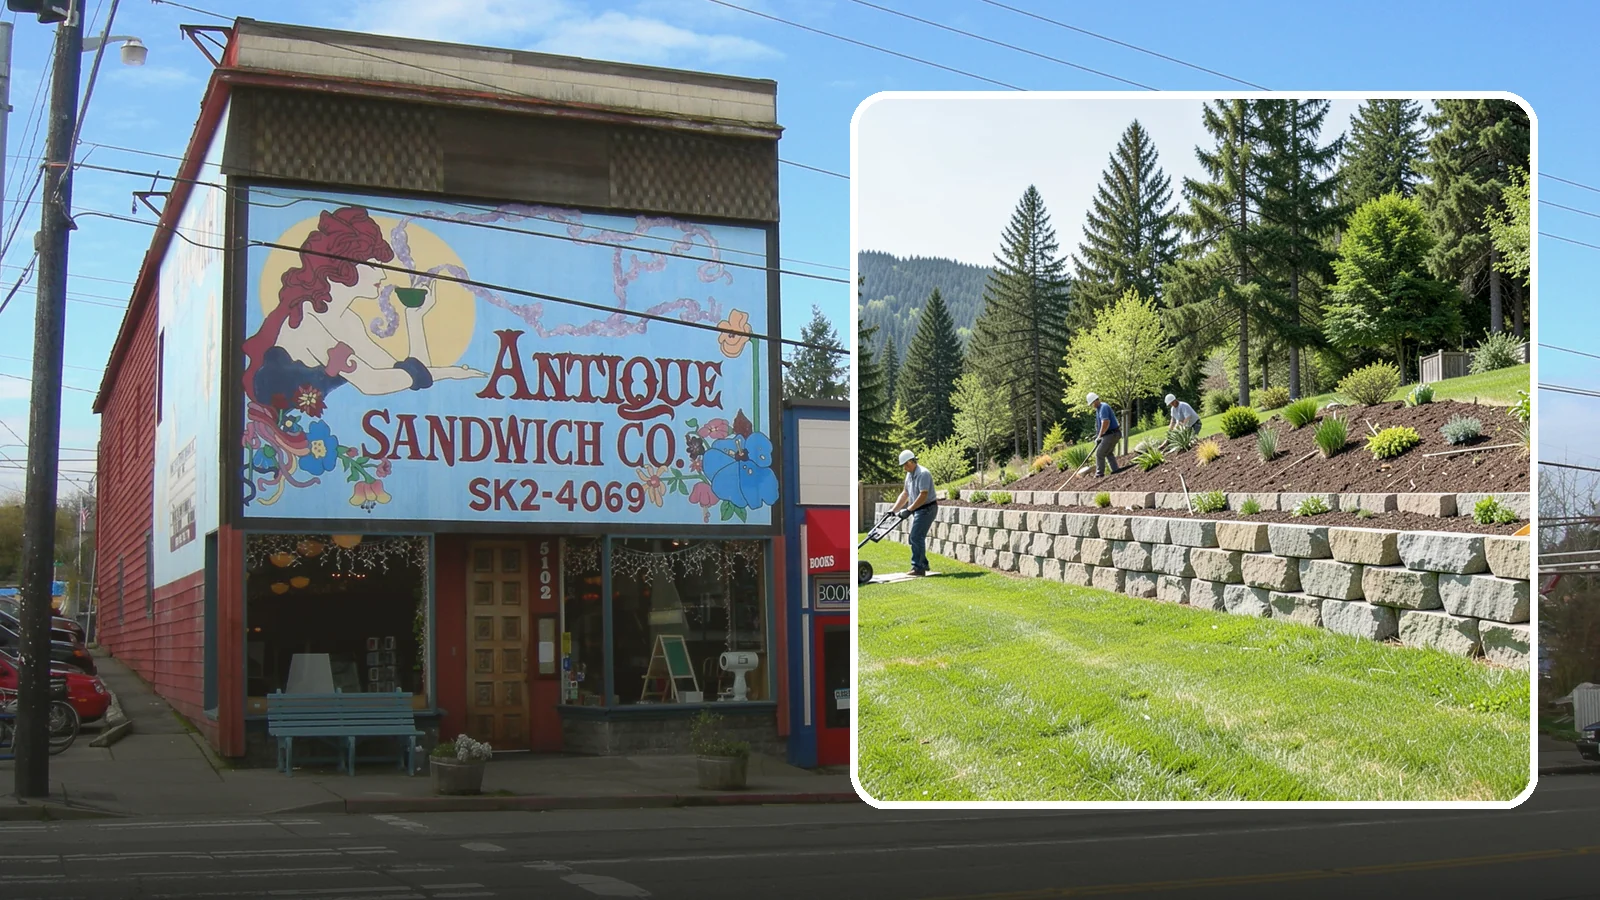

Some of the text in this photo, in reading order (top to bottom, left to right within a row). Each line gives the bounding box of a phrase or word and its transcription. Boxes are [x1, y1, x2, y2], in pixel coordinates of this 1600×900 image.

[477, 329, 723, 421] ANTIQUE
[361, 409, 685, 469] SANDWICH CO.
[468, 477, 646, 513] SK2-4069
[539, 541, 552, 600] 5102
[809, 554, 835, 569] BOOKS
